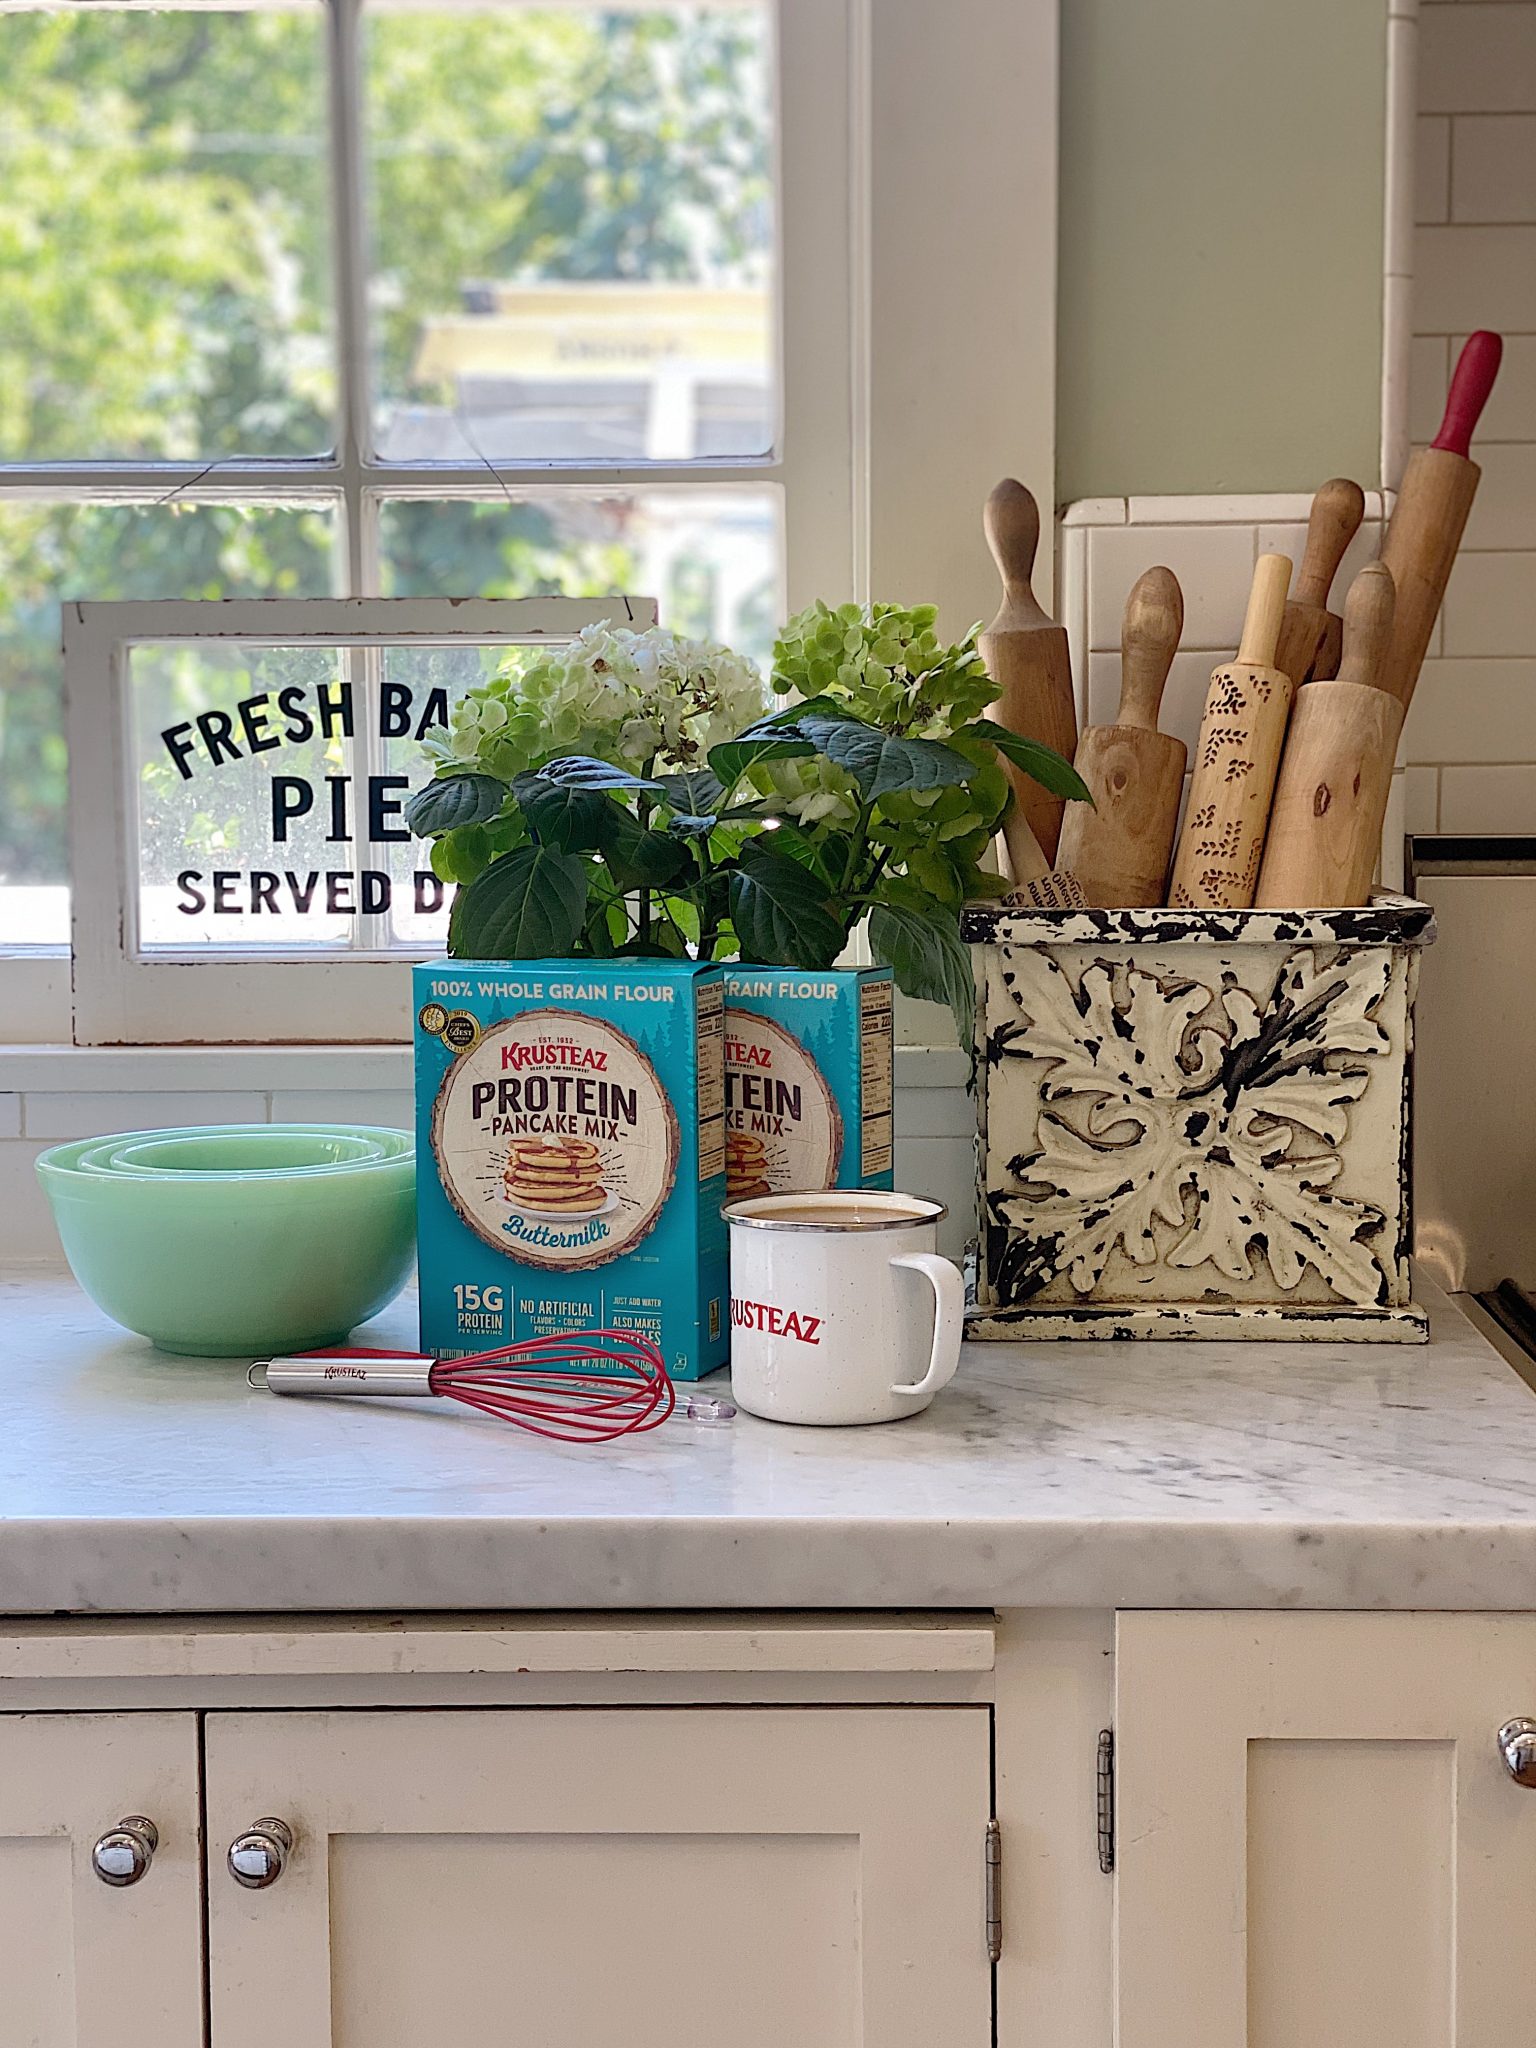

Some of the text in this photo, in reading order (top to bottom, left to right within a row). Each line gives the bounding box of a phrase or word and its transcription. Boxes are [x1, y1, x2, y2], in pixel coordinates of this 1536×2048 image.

[161, 682, 452, 780] FRESH BA
[271, 776, 414, 842] PIE
[177, 870, 392, 915] SERVED
[431, 981, 674, 1002] 100% WHOLE GRAIN FLOUR
[724, 982, 838, 1000] RAIN FLOUR
[538, 1036, 554, 1044] EST.
[501, 1041, 608, 1072] KRUSTEAZ
[724, 1041, 772, 1069] TEAZ
[472, 1075, 637, 1126] PROTEIN
[725, 1072, 802, 1122] TEIN
[501, 1214, 611, 1248] Buttermilk
[453, 1284, 504, 1311] 15G
[520, 1299, 595, 1317] NO ARTIFICIAL
[612, 1296, 662, 1308] JUST ADD WATER
[457, 1312, 503, 1330] PROTEIN
[473, 1328, 503, 1336] SERVING
[530, 1315, 586, 1327] FLAVORS COLORS
[612, 1316, 662, 1330] ALSO MAKES
[730, 1298, 821, 1346] RUSTEAZ
[324, 1366, 368, 1380] KRUSTEAZ
